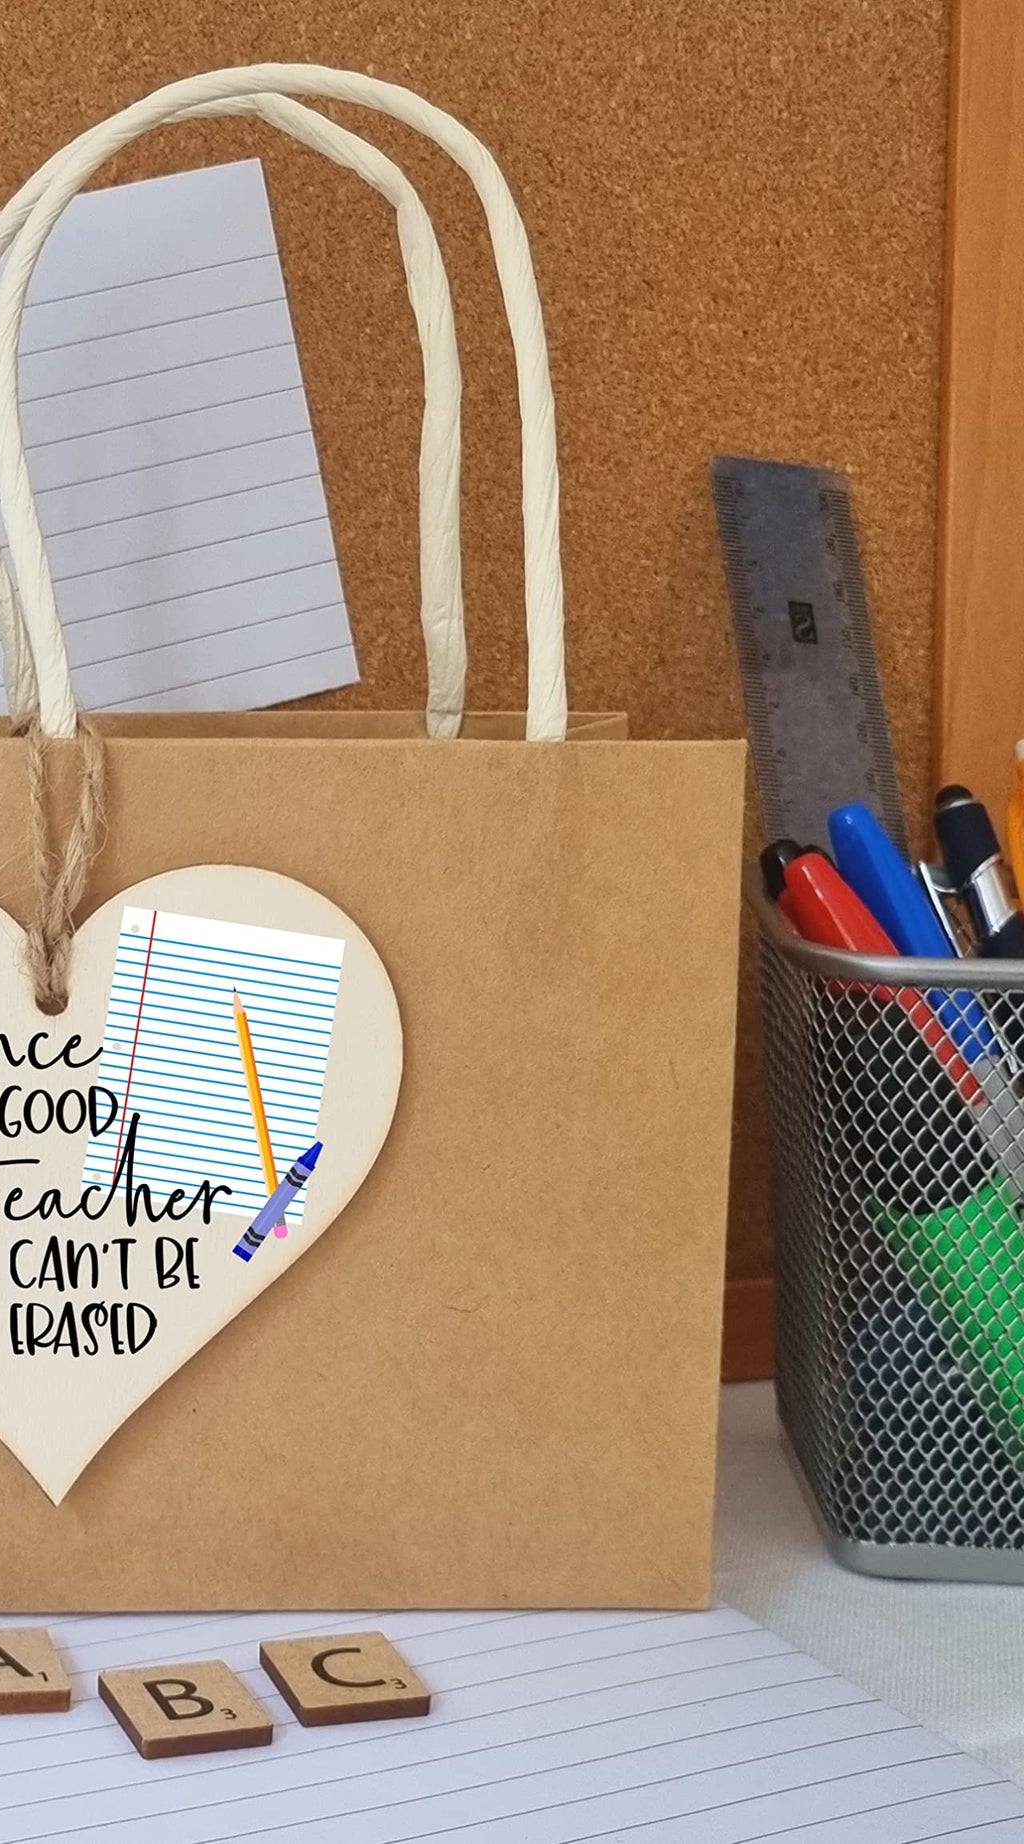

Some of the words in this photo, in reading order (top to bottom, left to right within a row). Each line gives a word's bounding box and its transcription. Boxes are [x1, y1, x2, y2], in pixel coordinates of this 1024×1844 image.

[155, 1236, 201, 1290] BE
[9, 1300, 158, 1358] ERASED
[38, 1672, 48, 1683] 1
[310, 1646, 386, 1688] C
[388, 1678, 407, 1690] 3
[142, 1678, 215, 1721] B
[220, 1707, 237, 1720] 3
